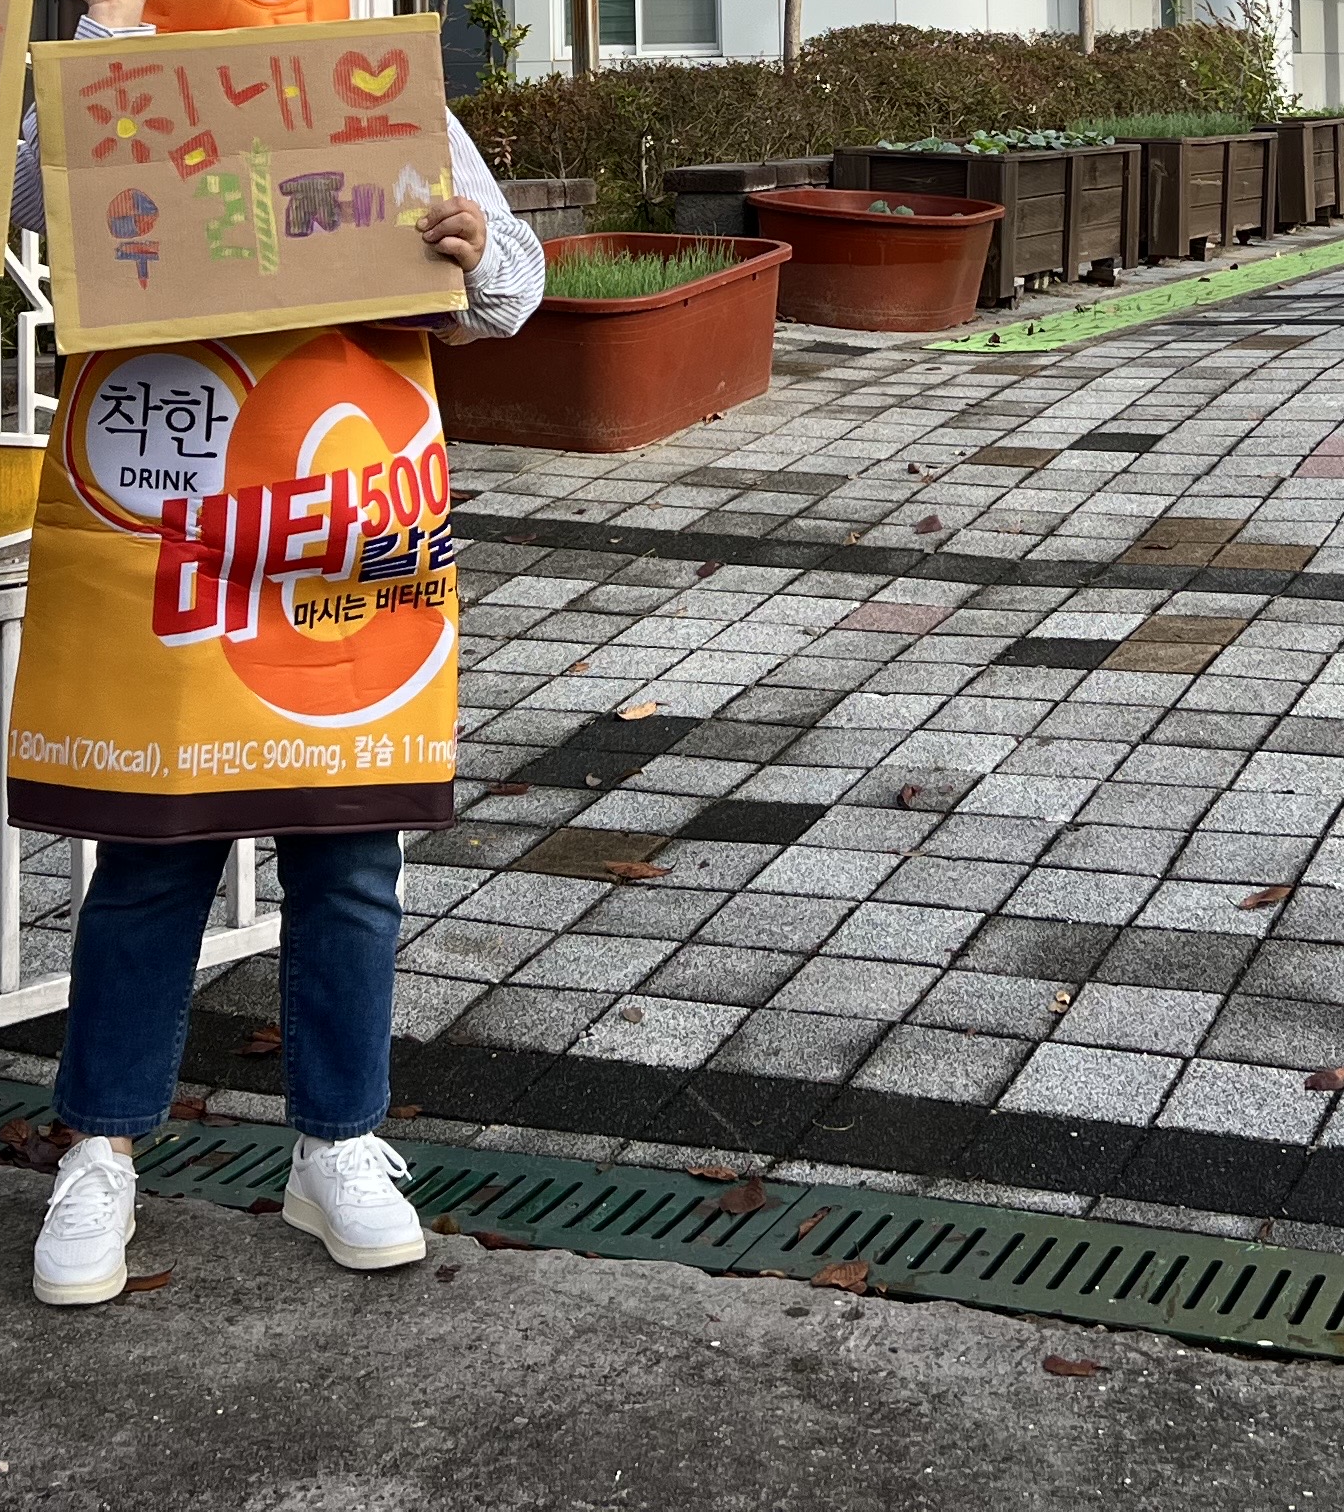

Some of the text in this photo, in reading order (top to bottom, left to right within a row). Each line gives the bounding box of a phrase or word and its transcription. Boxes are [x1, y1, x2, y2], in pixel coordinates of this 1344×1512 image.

[79, 49, 421, 179] 힘내요
[106, 136, 279, 290] 우리
[97, 381, 229, 458] 착한
[120, 467, 198, 492] DRINK
[294, 577, 458, 629] 마시는 비타민-
[177, 738, 258, 778] 비타민C
[263, 738, 346, 775] 900mg,
[354, 733, 394, 769] 칼슘
